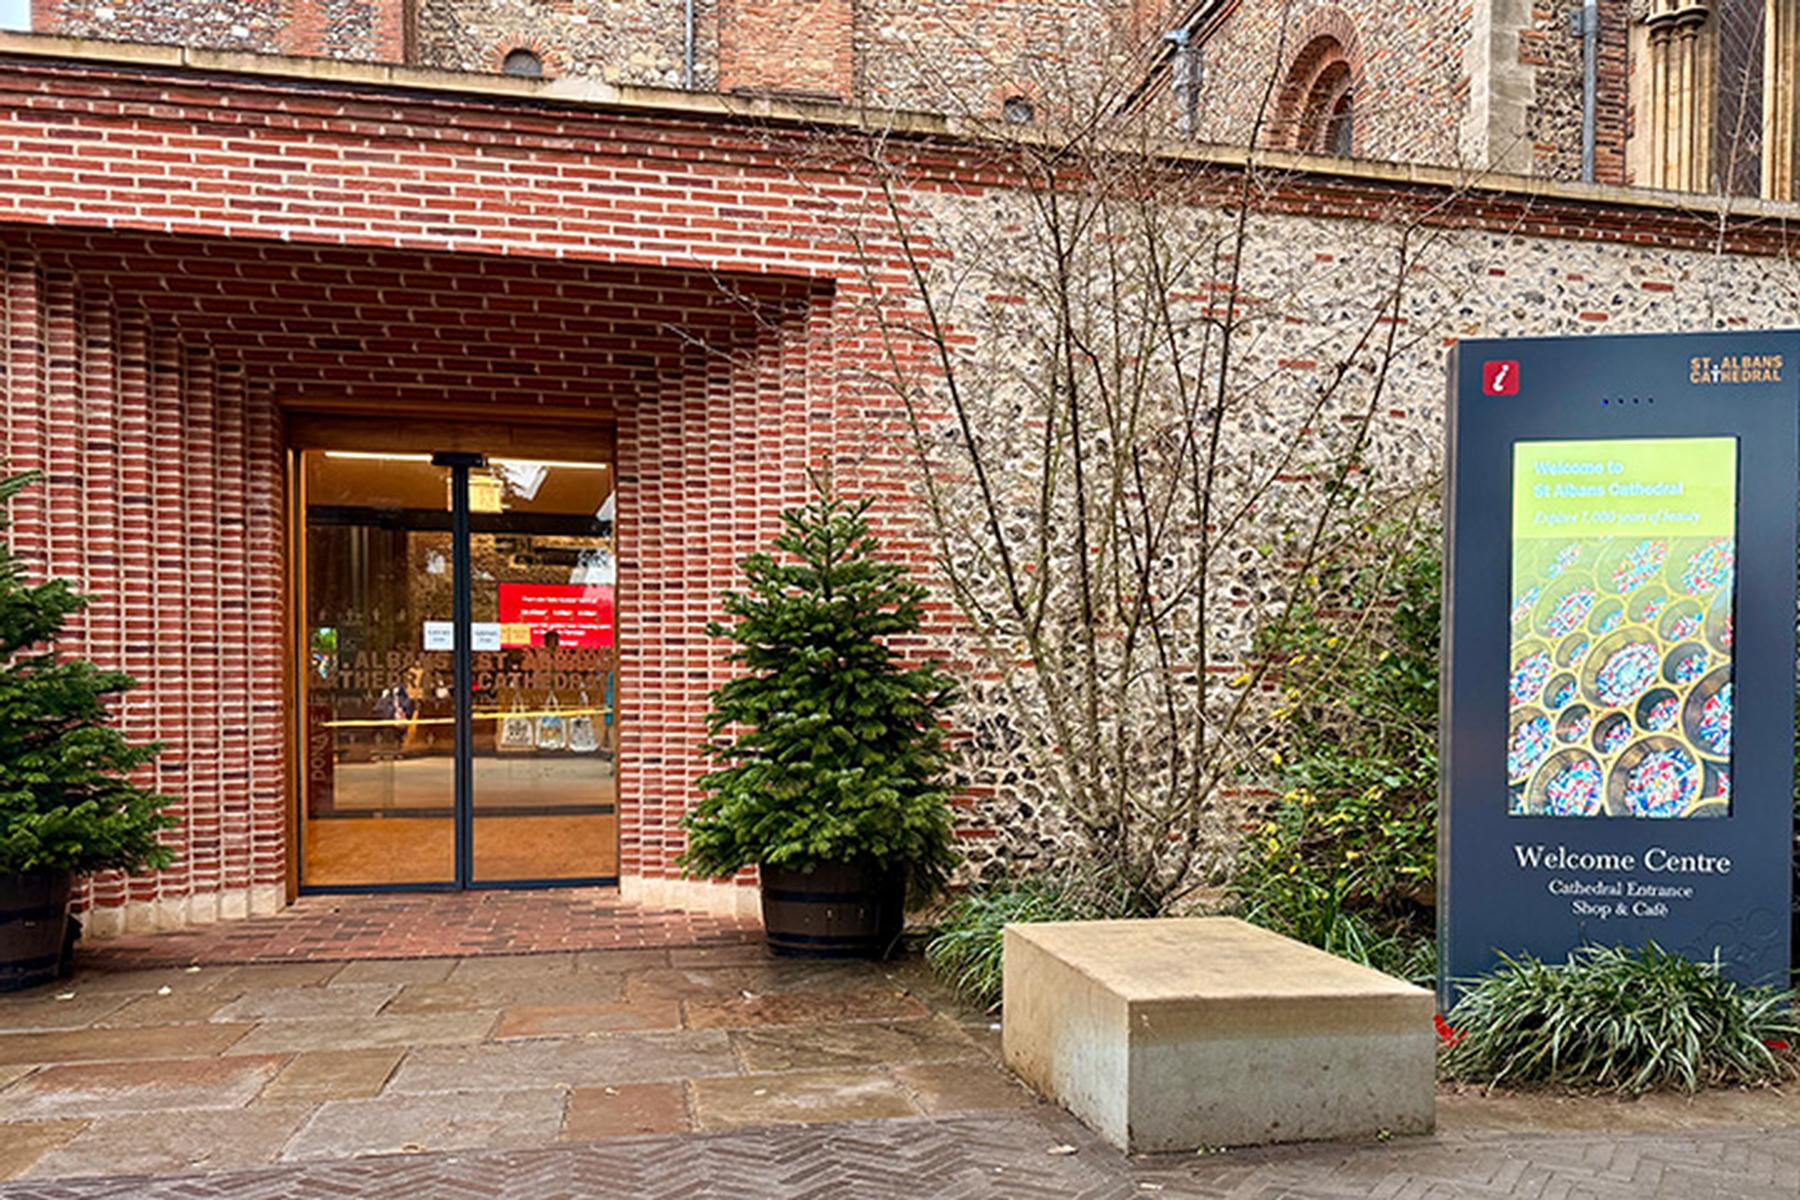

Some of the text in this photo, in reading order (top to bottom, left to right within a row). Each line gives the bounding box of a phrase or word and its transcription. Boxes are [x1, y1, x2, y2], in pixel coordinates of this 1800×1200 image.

[1721, 355, 1783, 369] ALBANS
[1690, 366, 1782, 384] CATHEDRAL
[1534, 459, 1624, 475] Welcome to
[1534, 481, 1684, 498] St Albans Cathedral
[1515, 846, 1731, 873] Welcome Centre
[1548, 879, 1693, 897] Cathedral Entrance
[1572, 901, 1611, 919] Shop
[1615, 902, 1629, 916] &
